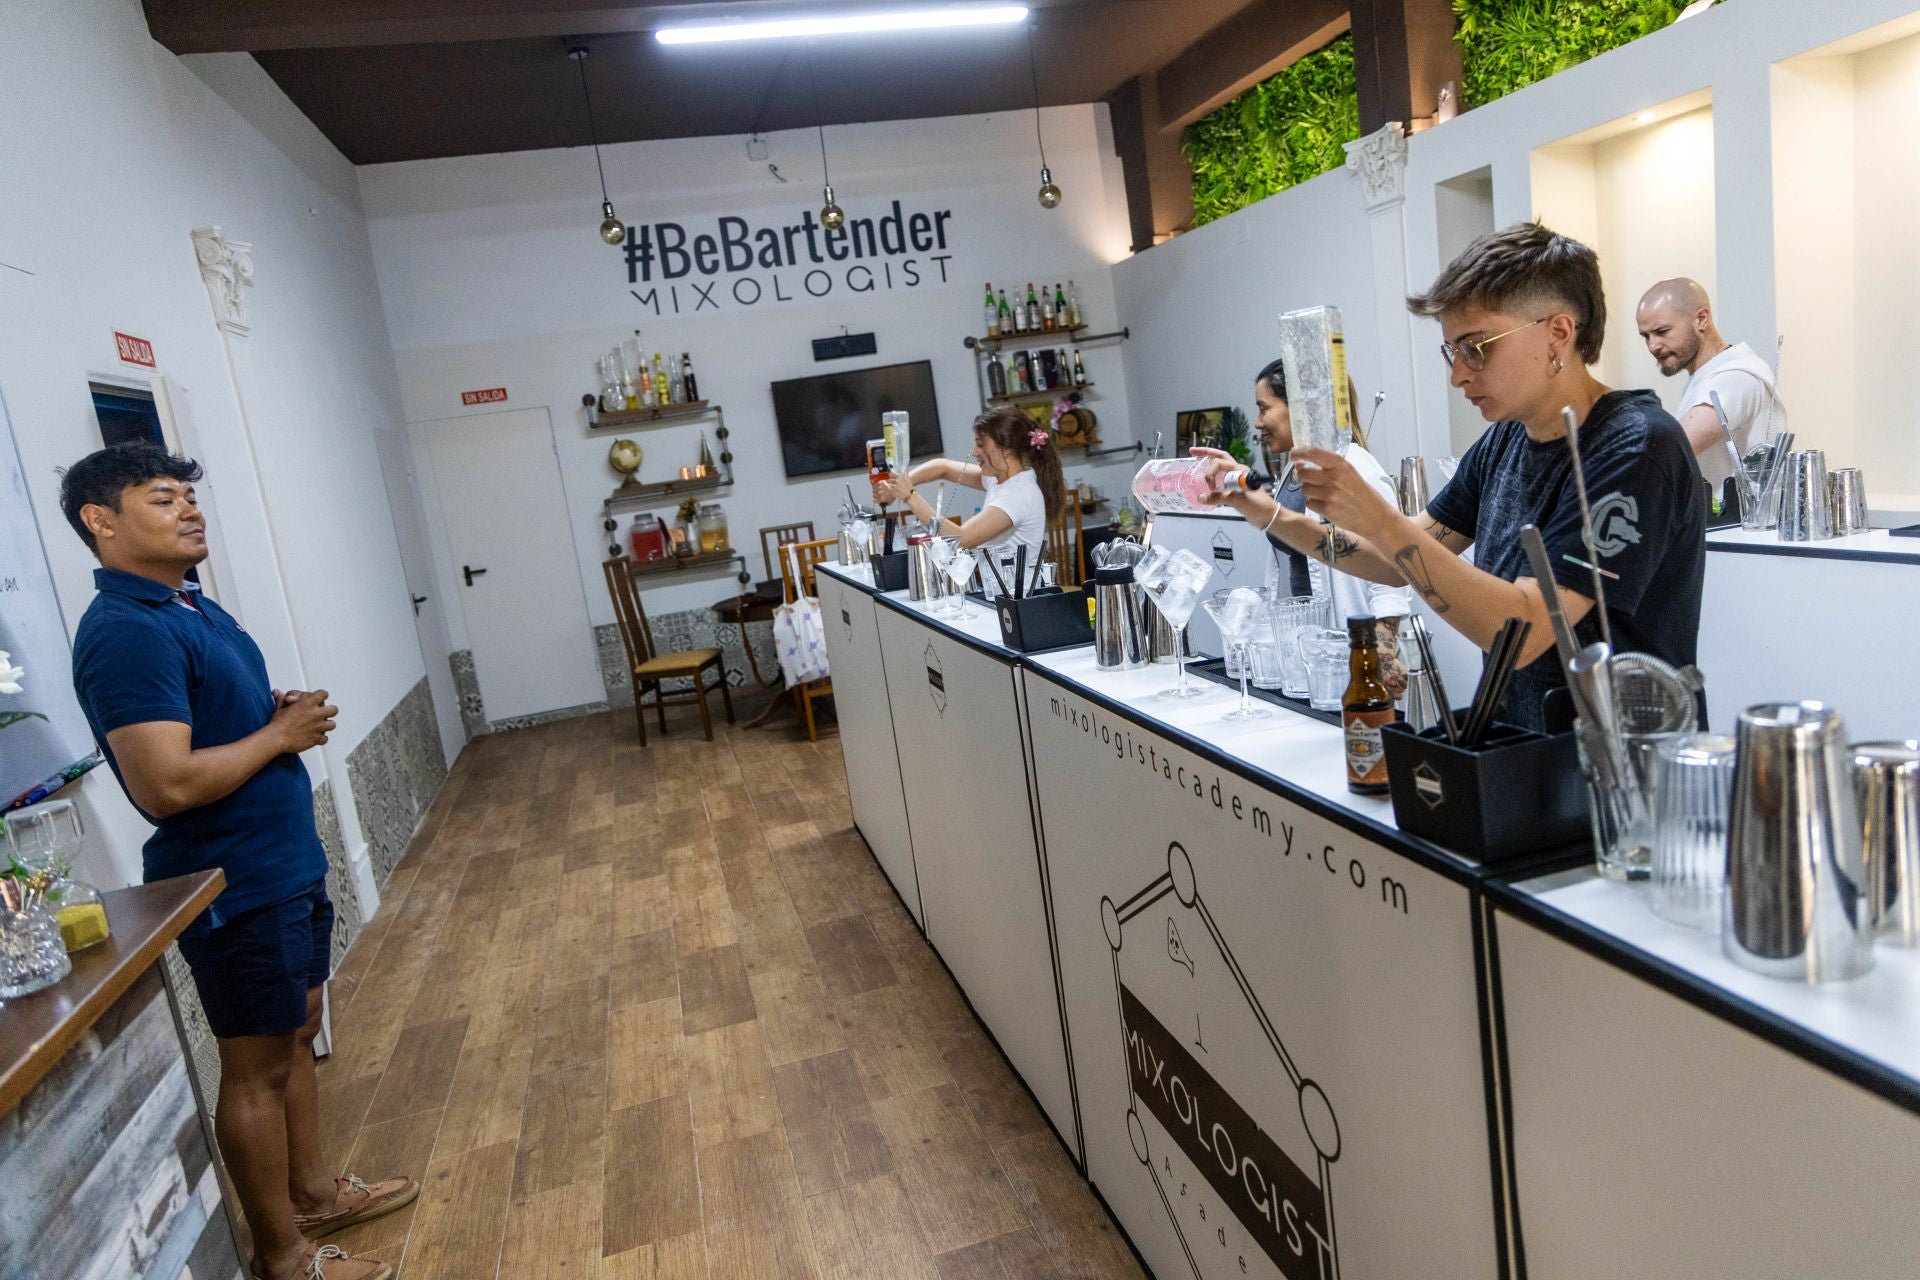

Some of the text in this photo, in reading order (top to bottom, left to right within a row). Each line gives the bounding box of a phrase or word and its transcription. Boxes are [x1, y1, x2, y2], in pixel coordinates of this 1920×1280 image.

[621, 200, 952, 283] #BeBartender
[630, 255, 953, 316] MIXOLOGIST
[129, 338, 154, 364] SALIDA
[464, 389, 506, 404] SIN SALIDA
[1050, 694, 1409, 915] mixologistacademy.com
[1122, 1017, 1331, 1280] MIXOLOGIST
